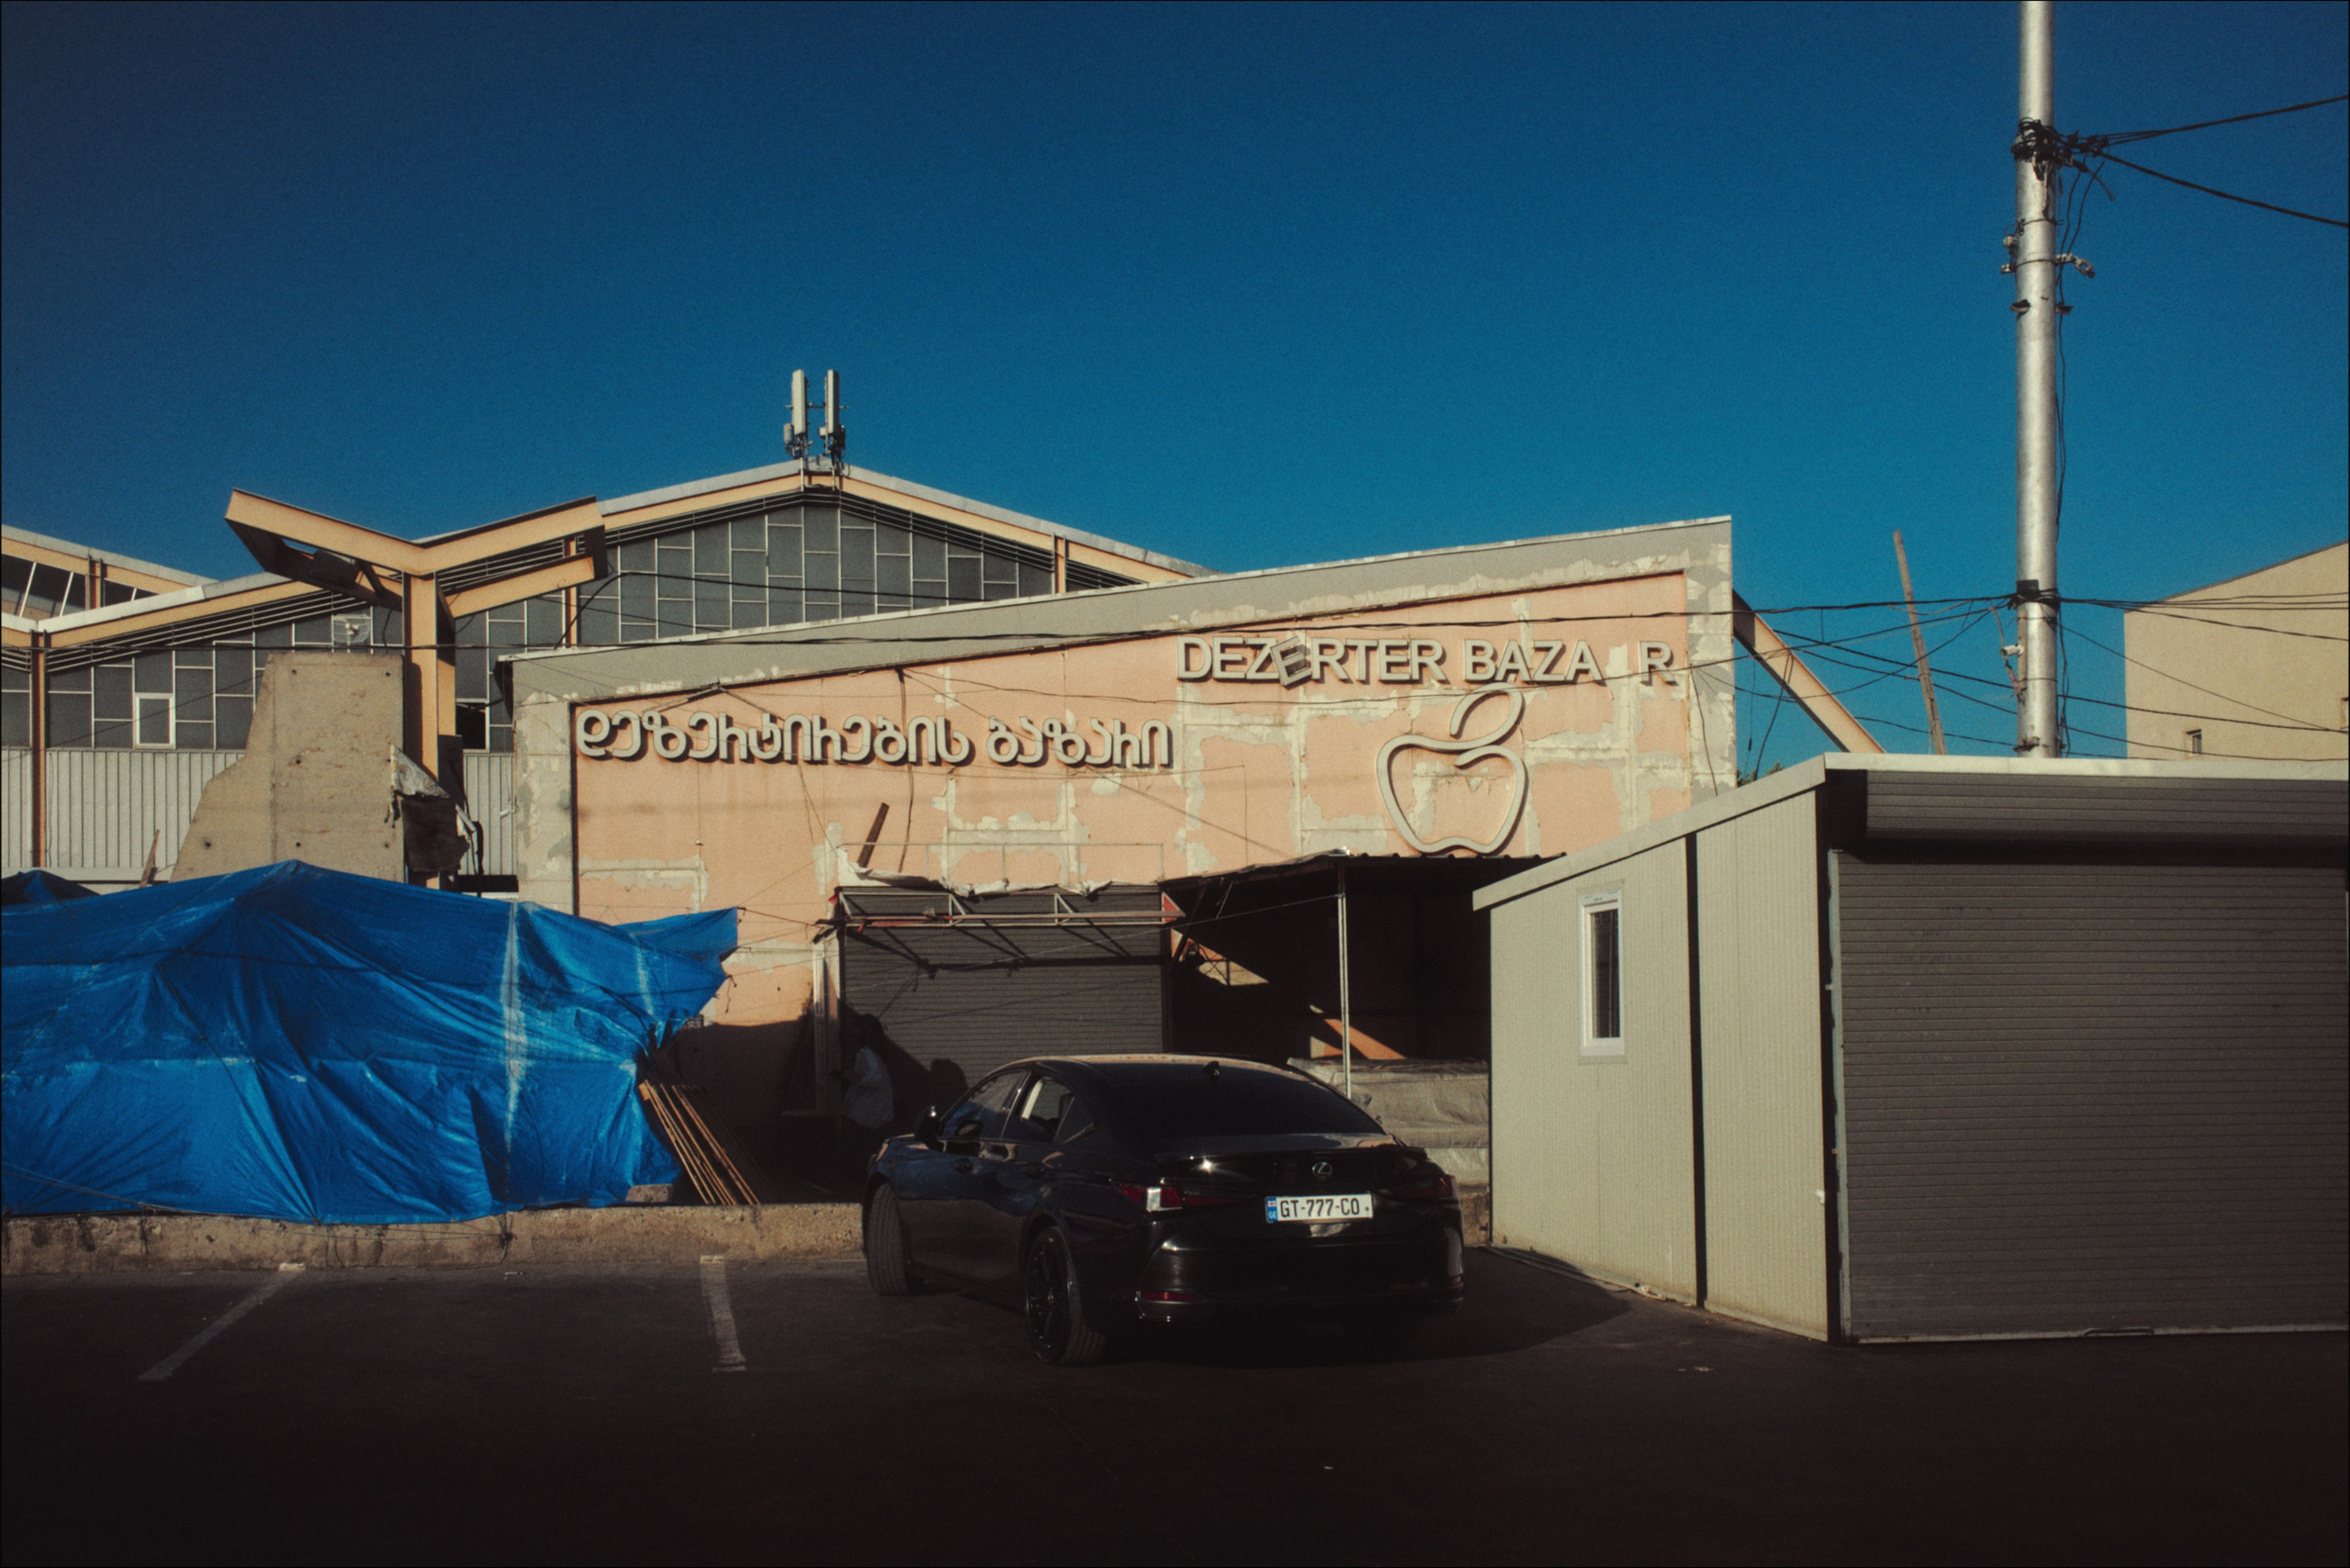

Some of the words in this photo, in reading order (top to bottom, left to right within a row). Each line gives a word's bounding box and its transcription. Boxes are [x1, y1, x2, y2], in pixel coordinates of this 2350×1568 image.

[1177, 635, 1446, 688] DEZERTER
[576, 709, 970, 764] დეზერტირების
[985, 715, 1170, 766] ბაზარი
[1268, 1211, 1278, 1220] GE
